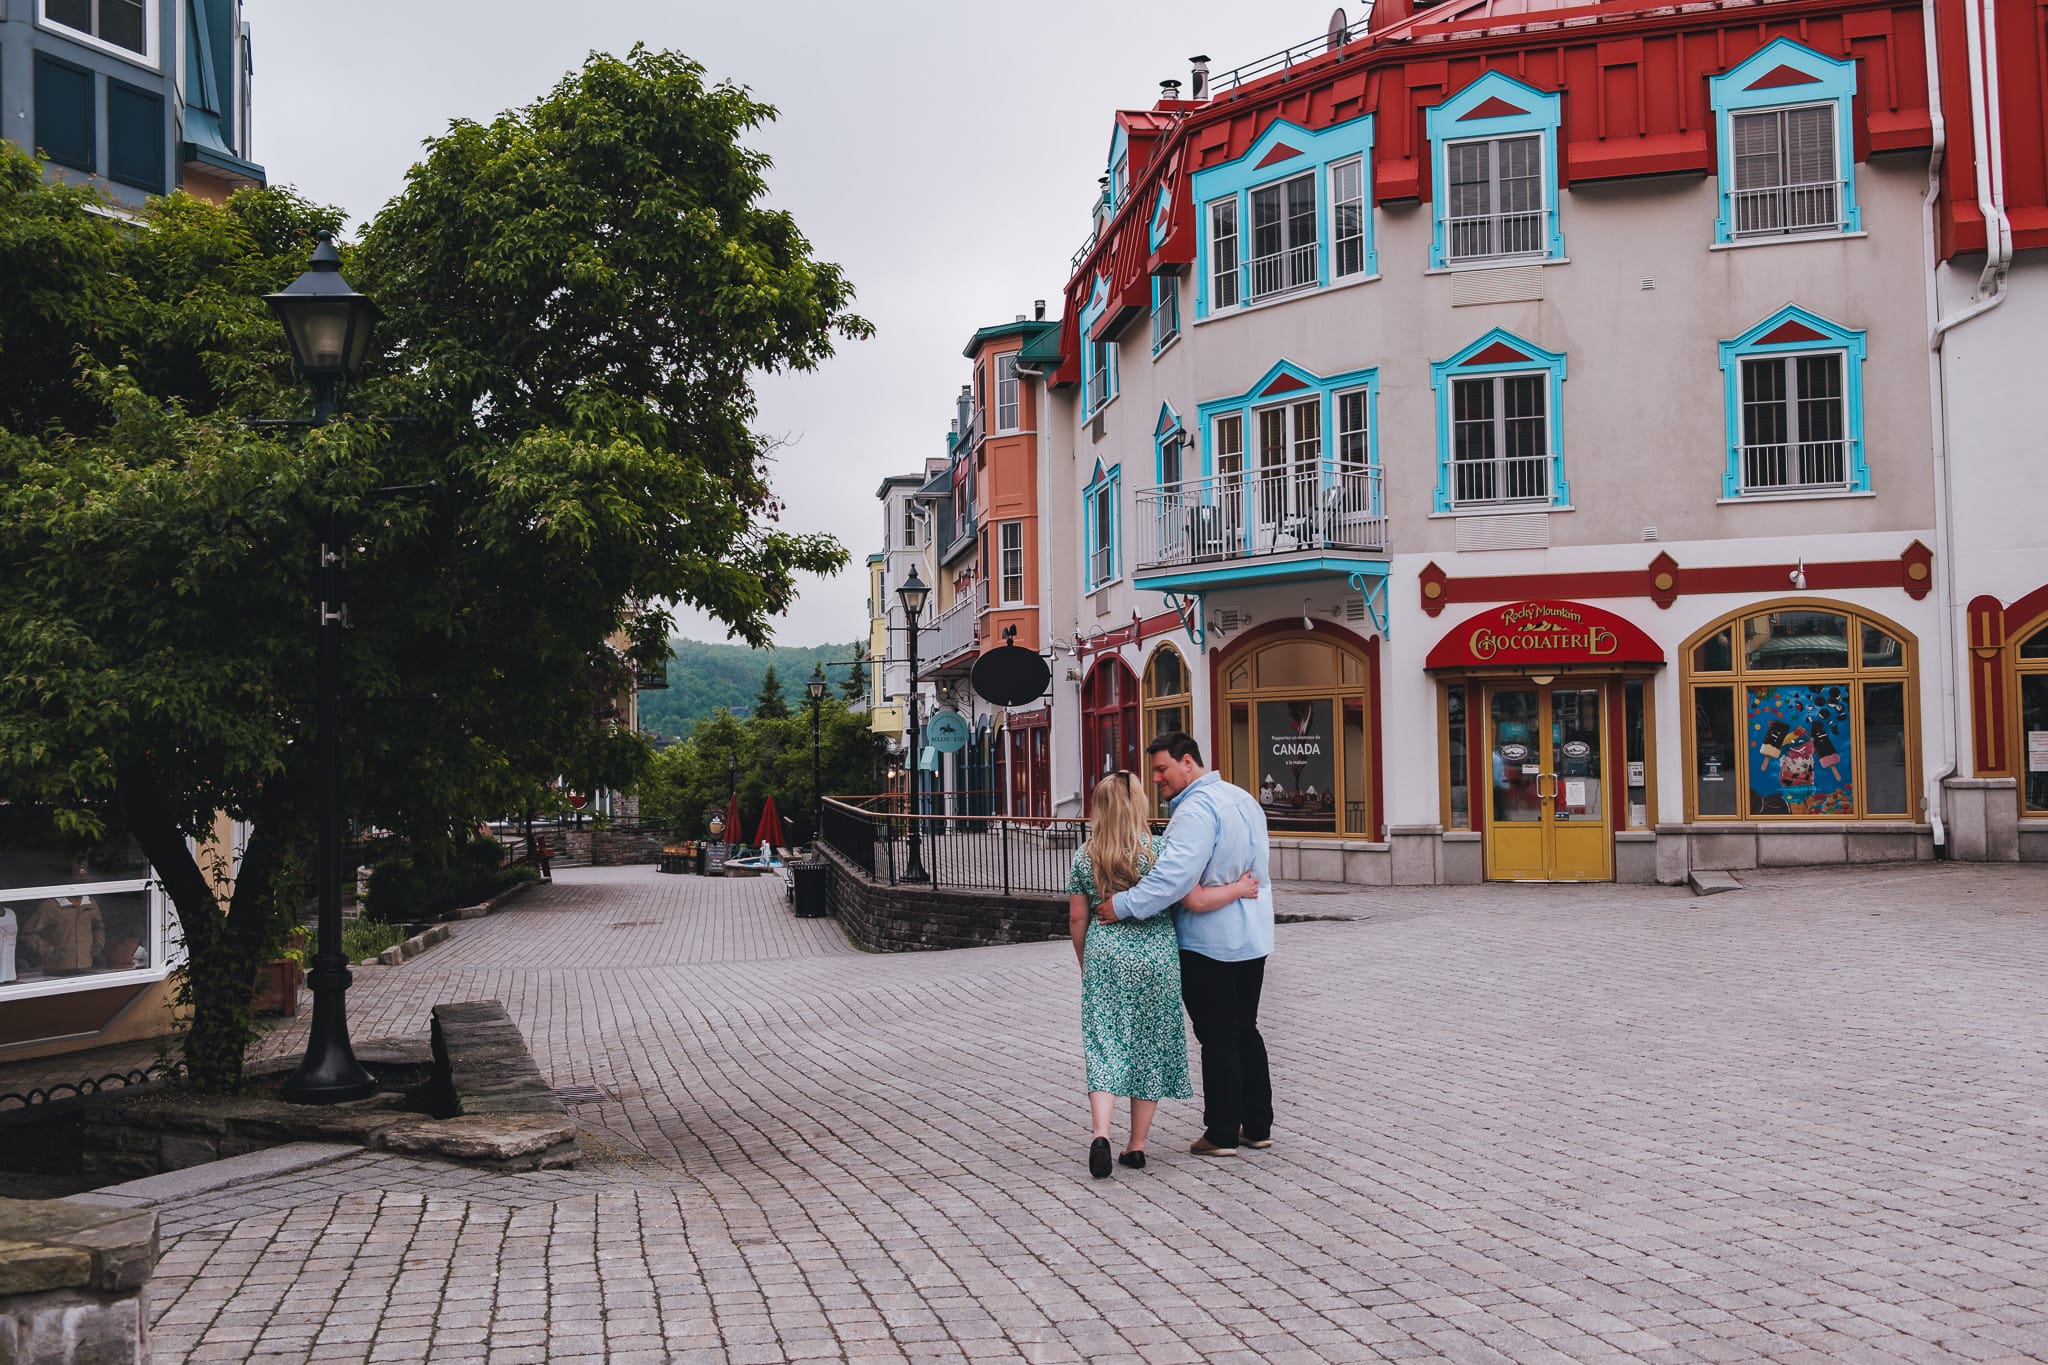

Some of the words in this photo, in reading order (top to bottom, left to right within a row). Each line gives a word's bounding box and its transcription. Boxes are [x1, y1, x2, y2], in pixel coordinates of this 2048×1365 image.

[1501, 604, 1534, 626] Rocky
[1530, 603, 1584, 625] Mountain
[1469, 626, 1618, 660] CHOCOLATERIE
[1272, 743, 1320, 755] CANADA
